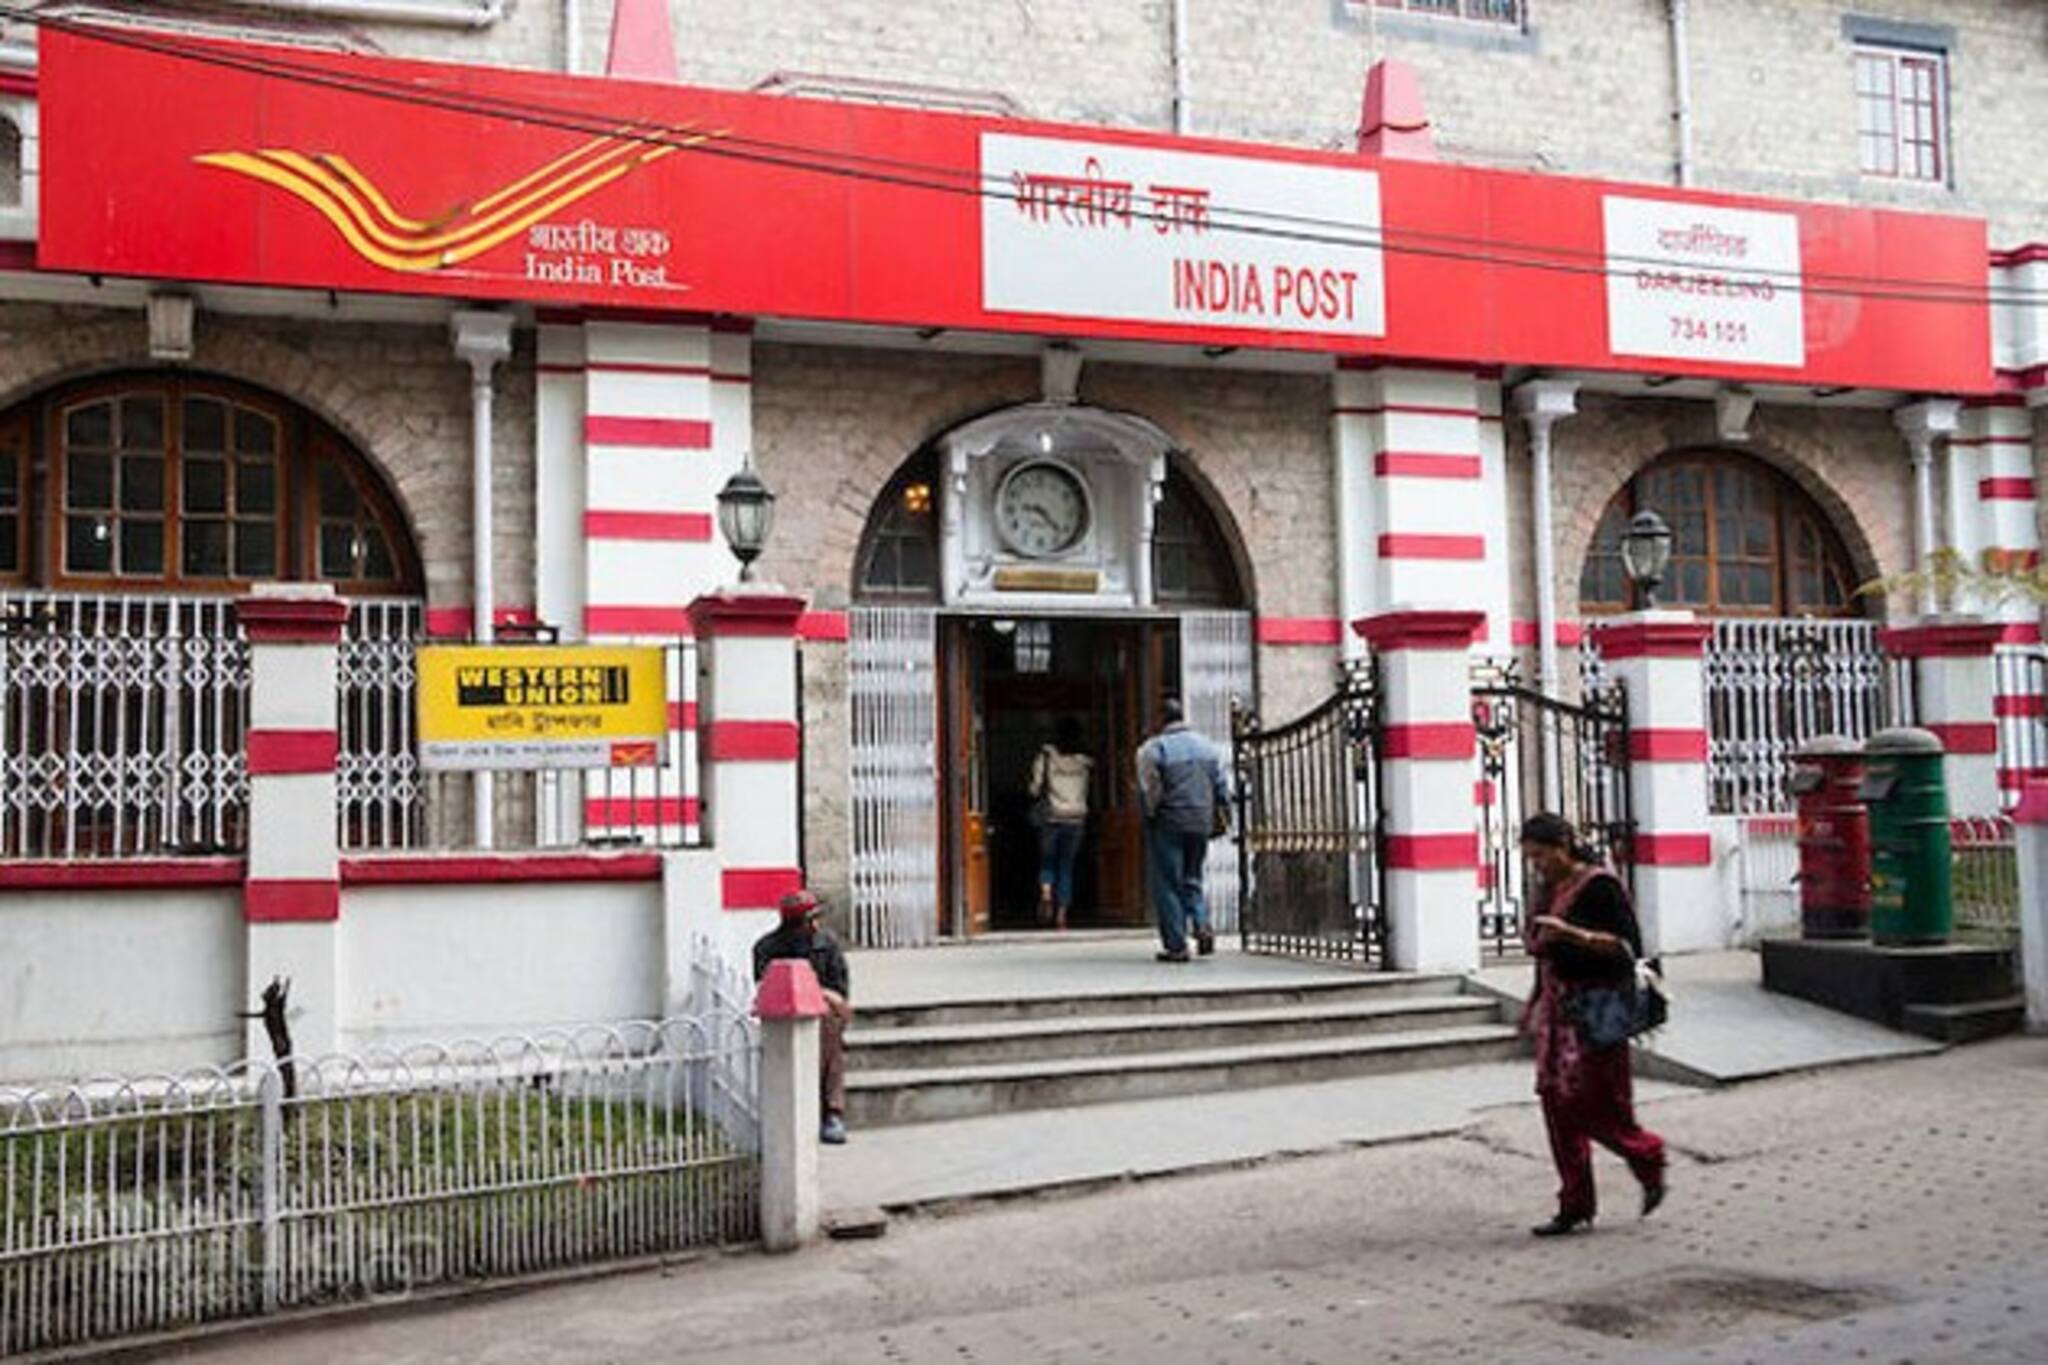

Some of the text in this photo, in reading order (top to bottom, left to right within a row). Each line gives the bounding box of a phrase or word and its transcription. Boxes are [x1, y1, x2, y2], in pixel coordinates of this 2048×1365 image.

[1013, 157, 1209, 235] भारतीय डाक
[529, 218, 617, 254] भारतीय
[525, 253, 668, 287] India Post
[1636, 269, 1776, 301] DARJEELING
[1174, 258, 1358, 320] INDIA POST
[460, 668, 601, 686] WESTERN
[505, 687, 601, 703] UNION
